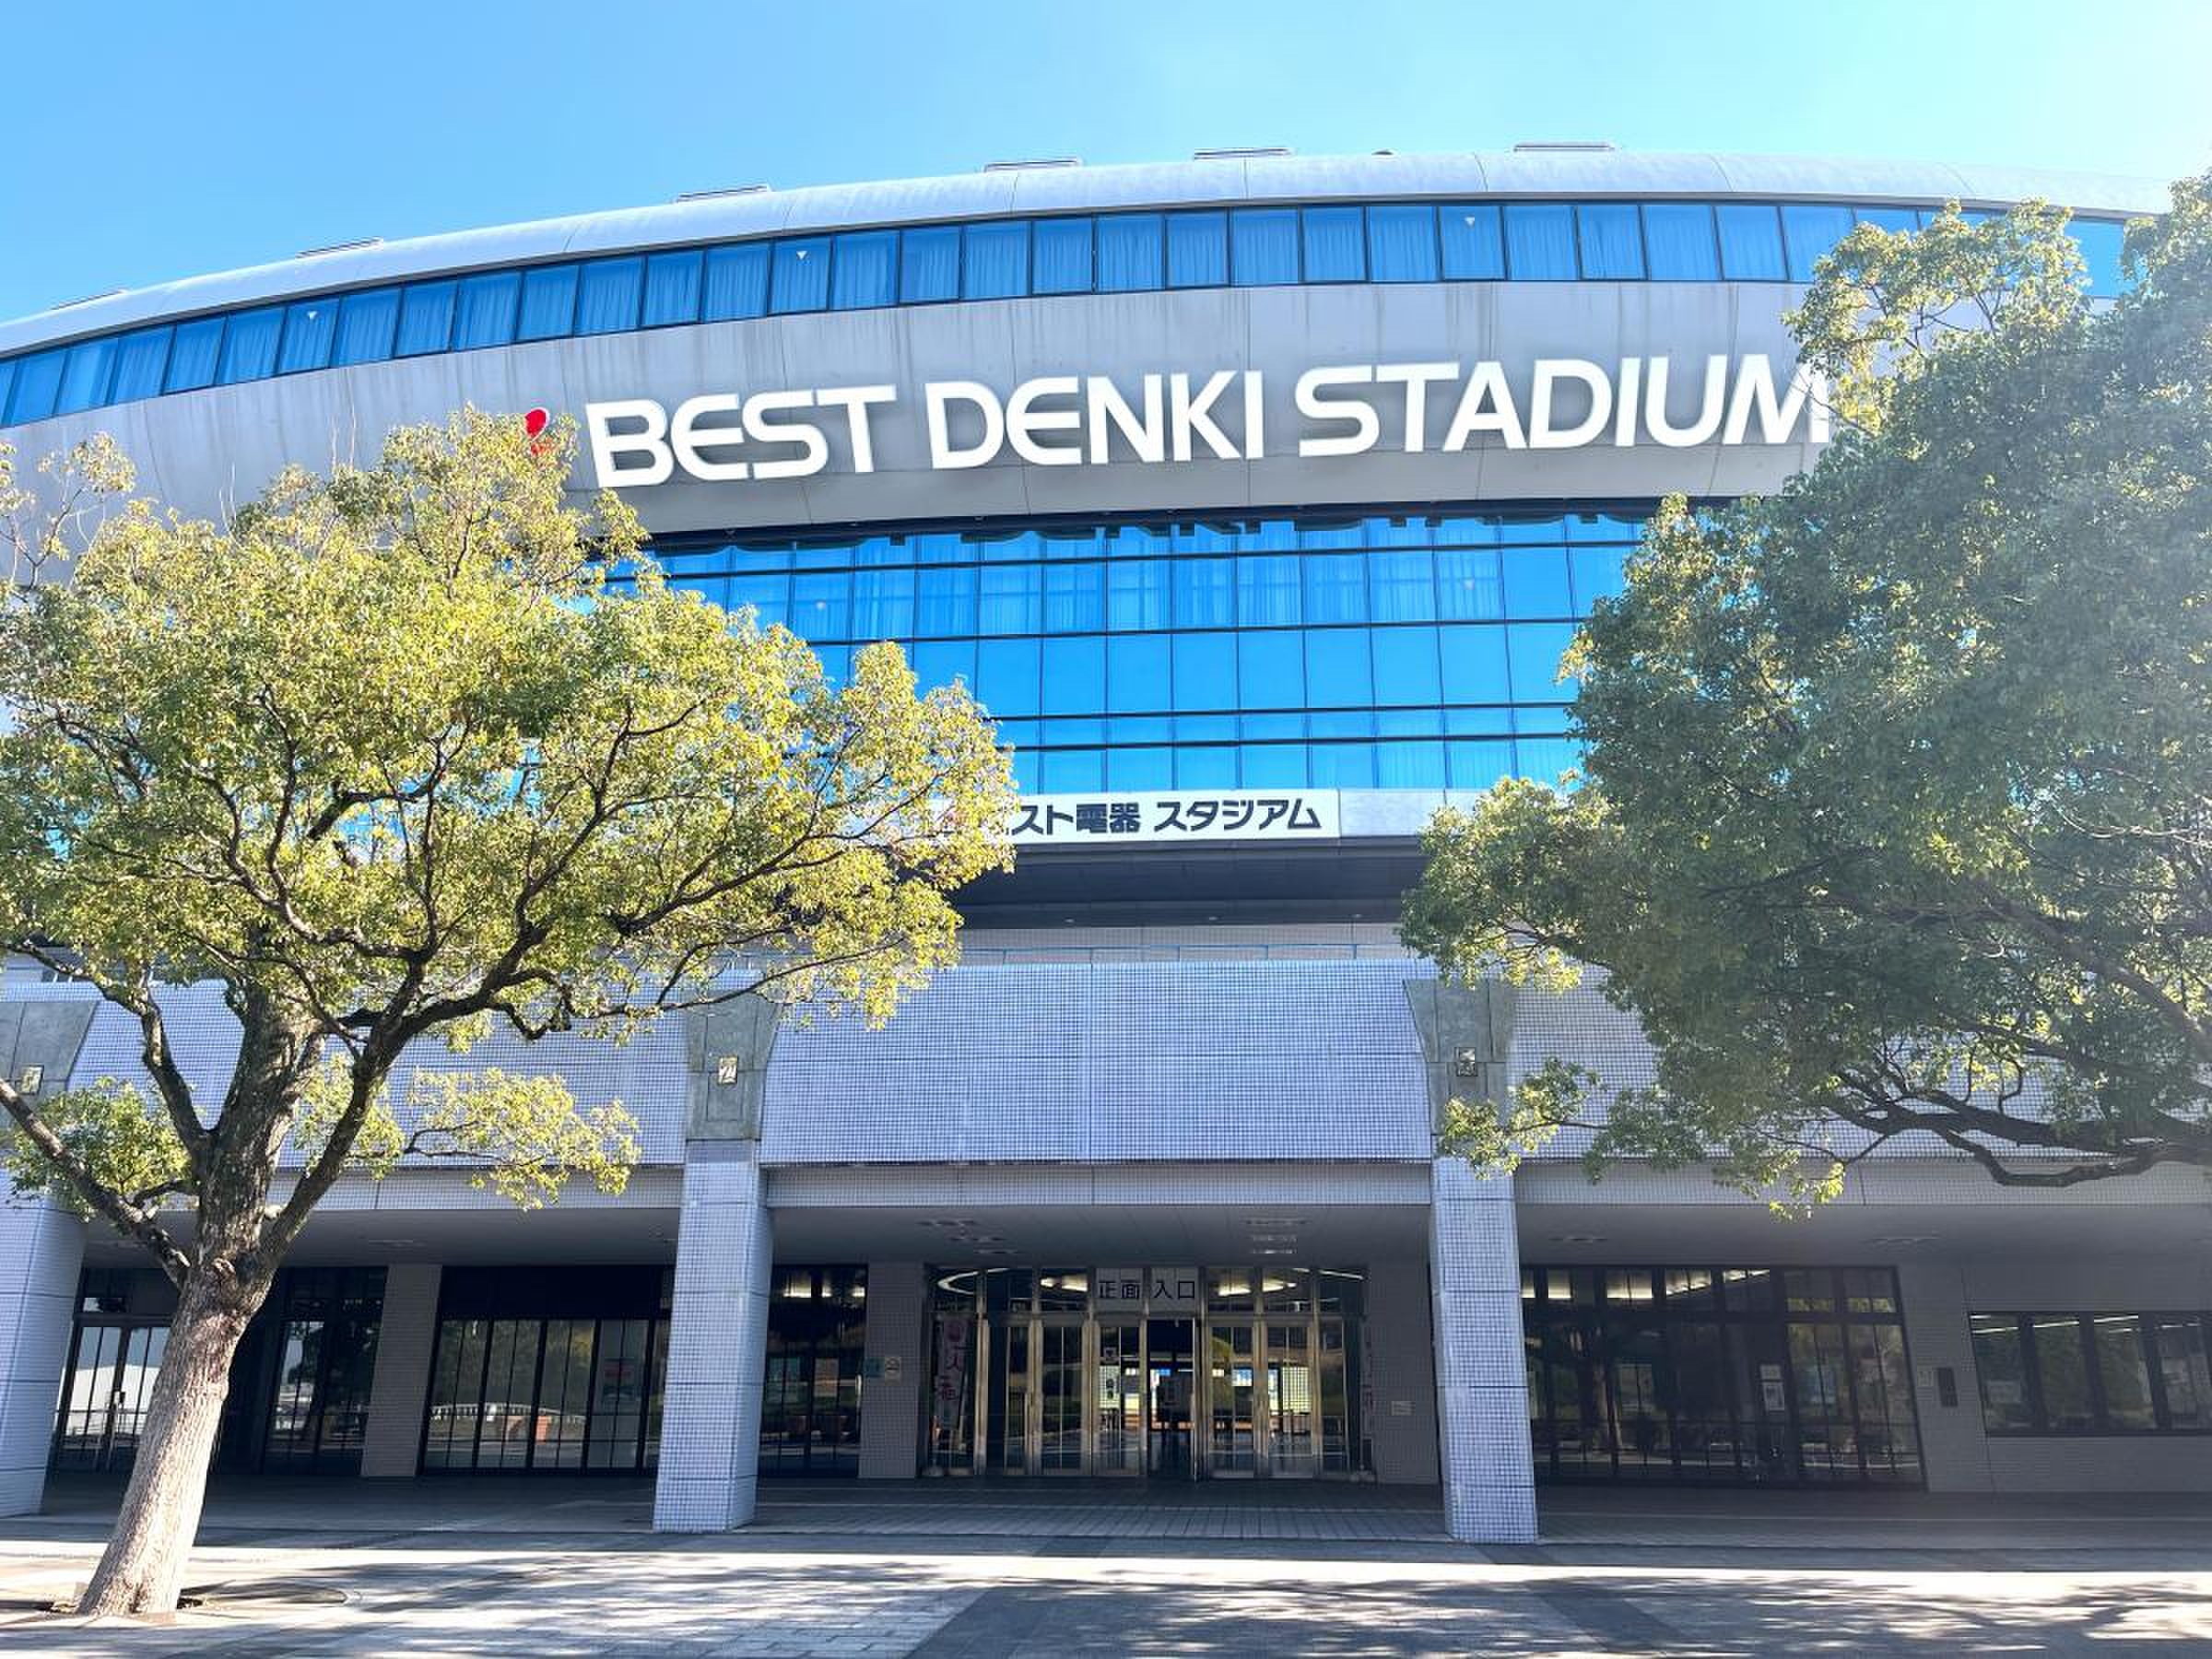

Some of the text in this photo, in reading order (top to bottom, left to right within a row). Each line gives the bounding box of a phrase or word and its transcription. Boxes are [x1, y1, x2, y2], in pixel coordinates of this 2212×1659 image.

[584, 354, 1830, 488] BEST DENKI STADIUM
[1003, 797, 1323, 836] スト電器 スタジアム
